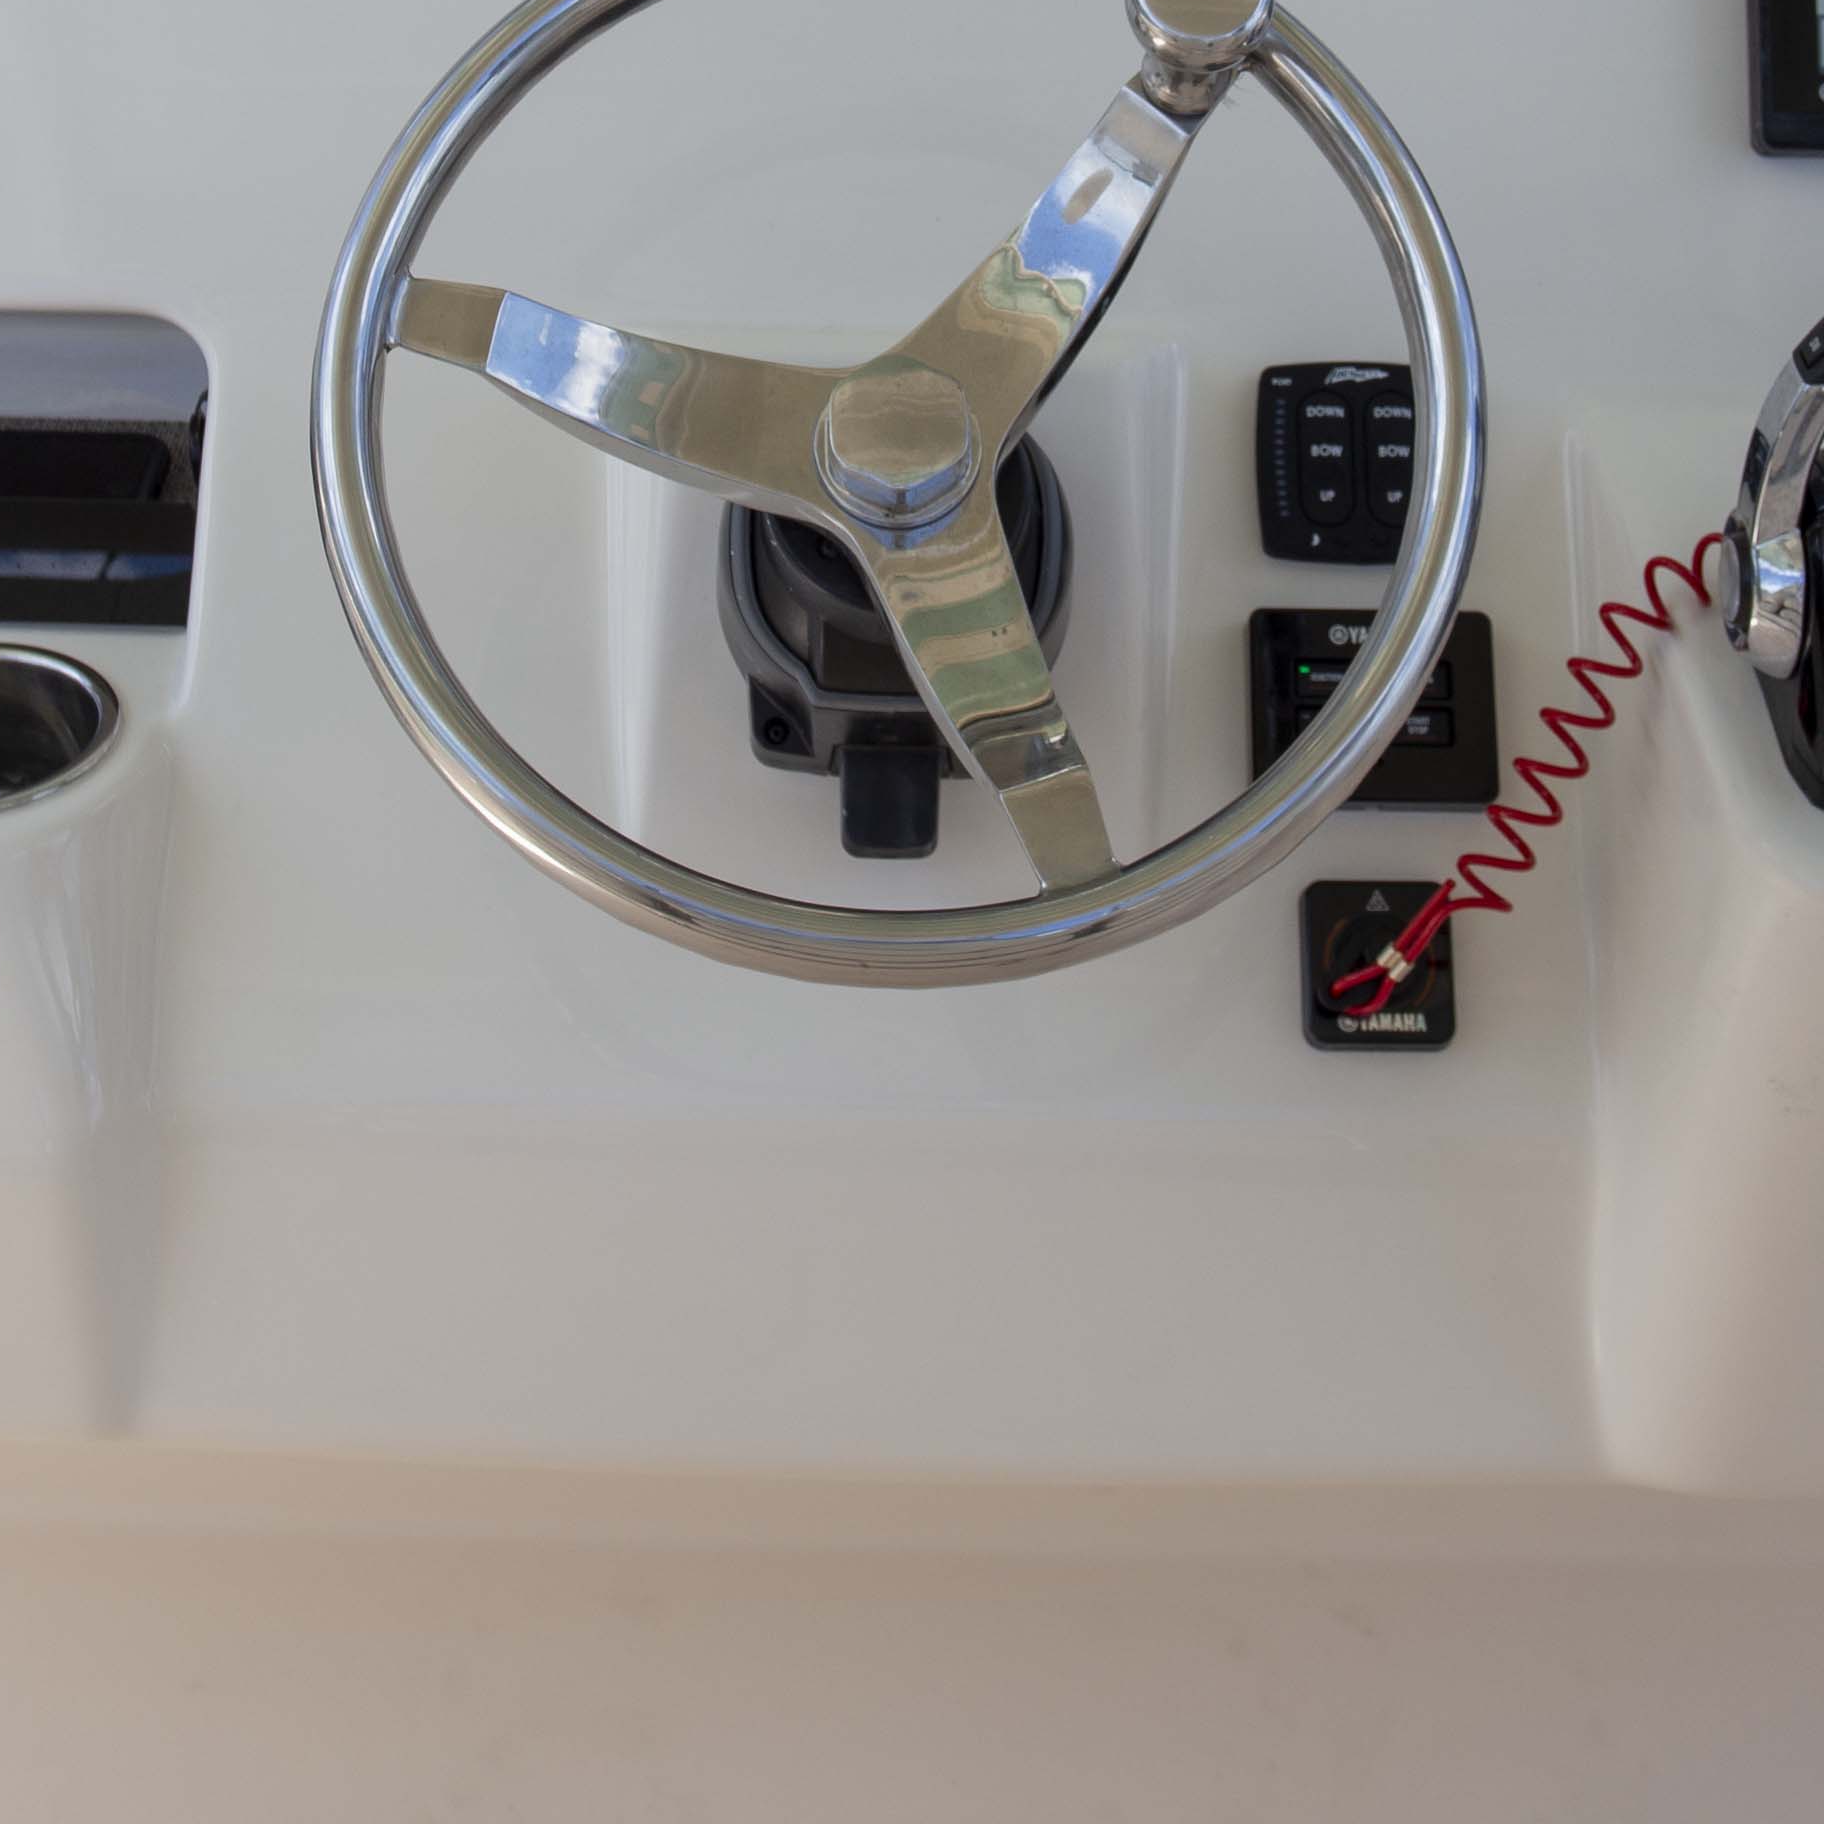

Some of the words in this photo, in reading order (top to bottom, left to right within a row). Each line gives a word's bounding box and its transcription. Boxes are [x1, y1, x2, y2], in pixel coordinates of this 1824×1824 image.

[1306, 405, 1345, 418] DOWN
[1373, 405, 1412, 419] DOWN
[1310, 444, 1343, 457] BOW
[1378, 444, 1410, 458] BOW
[1320, 489, 1336, 502] UP
[1387, 489, 1403, 503] UP
